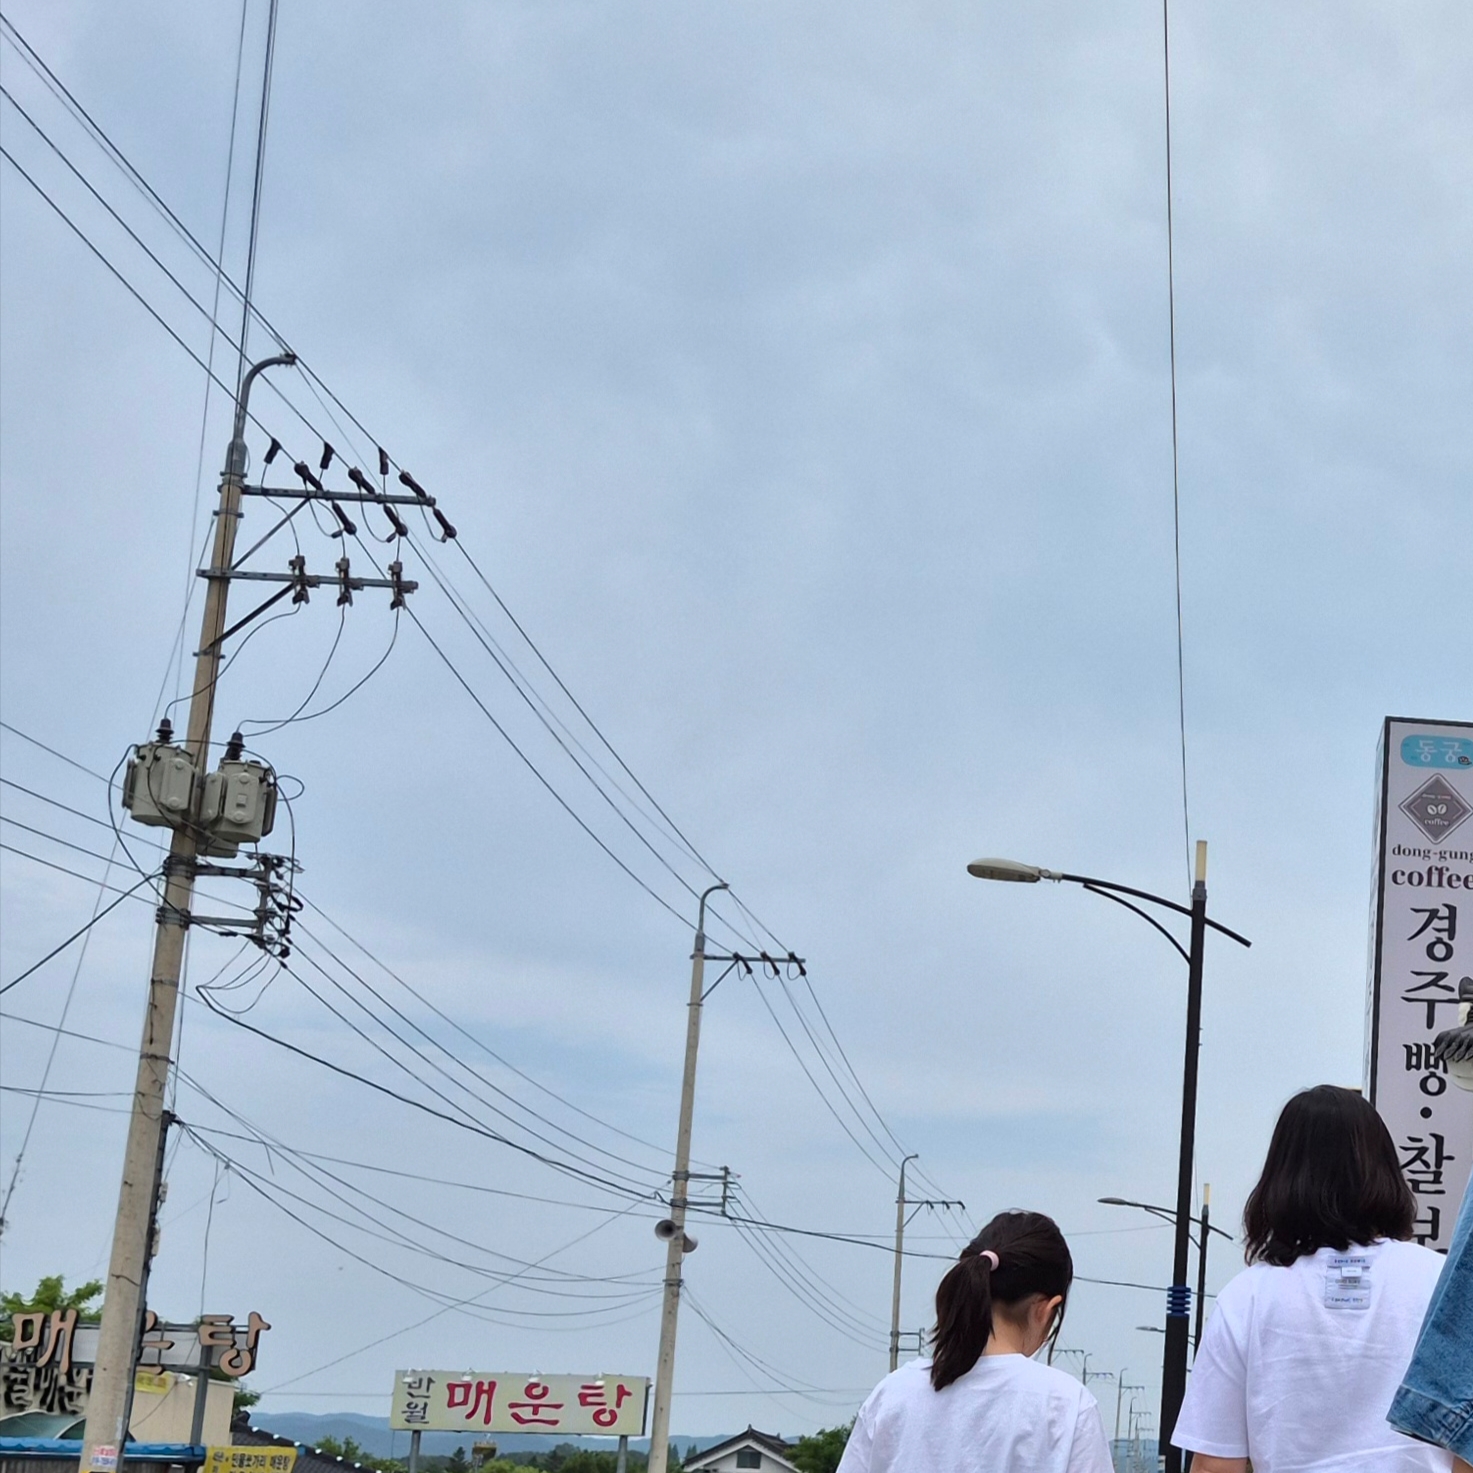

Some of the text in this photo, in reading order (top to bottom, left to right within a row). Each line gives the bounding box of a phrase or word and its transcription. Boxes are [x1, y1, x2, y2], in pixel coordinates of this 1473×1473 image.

[1415, 740, 1462, 763] 동궁
[401, 1376, 633, 1428] 반월 매운탕
